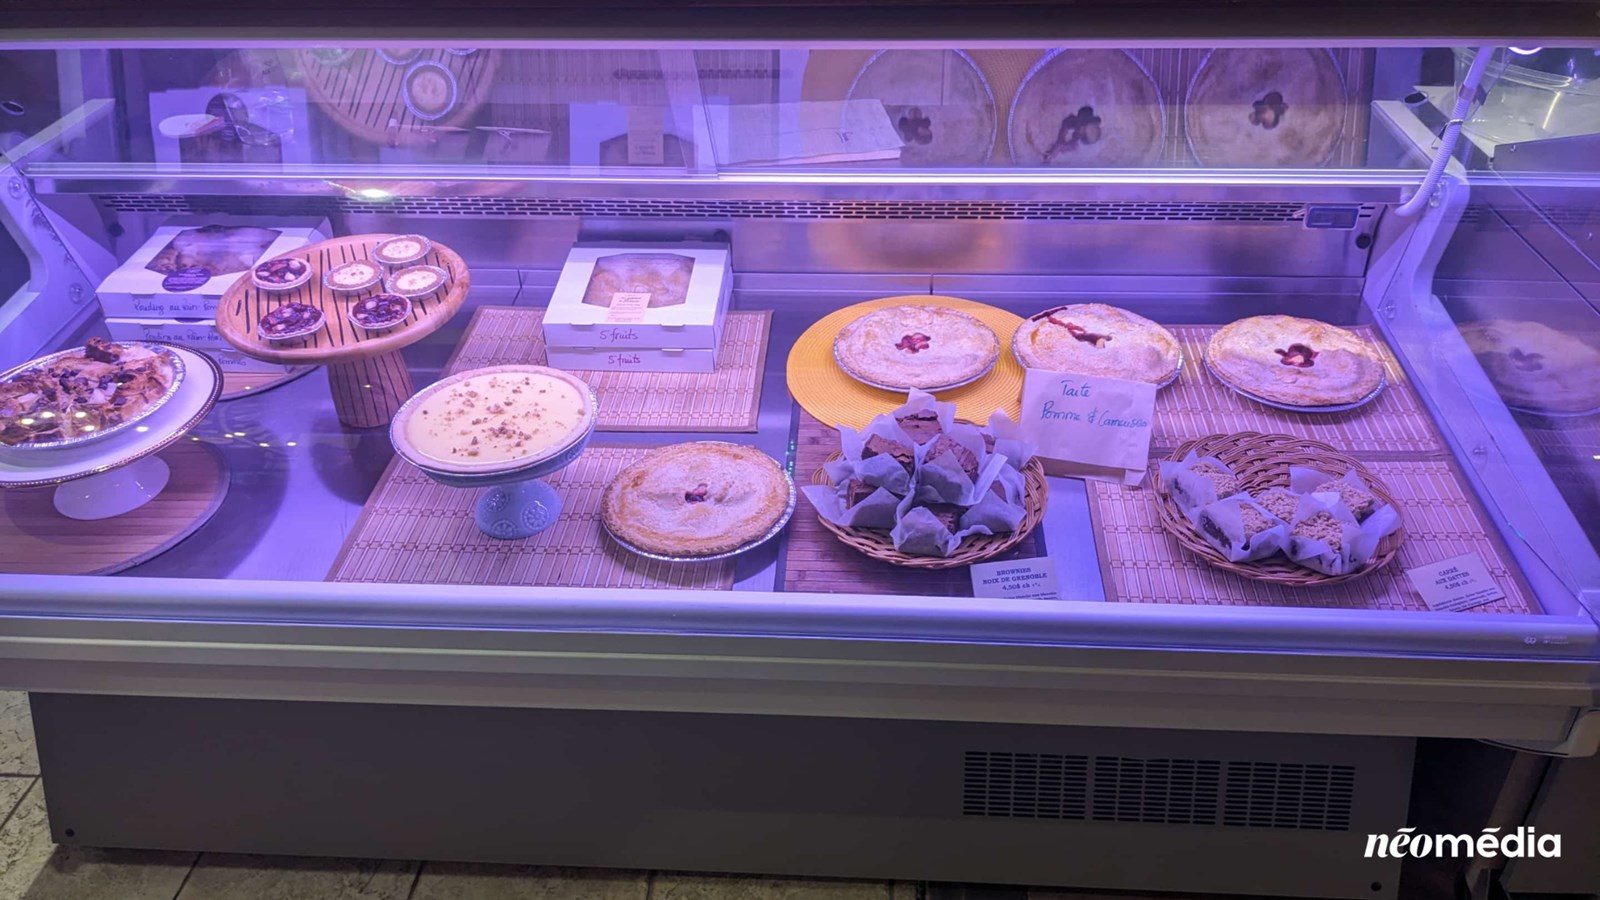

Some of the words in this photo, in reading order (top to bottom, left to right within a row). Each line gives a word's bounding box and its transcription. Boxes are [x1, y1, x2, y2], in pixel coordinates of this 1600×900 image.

[600, 330, 610, 340] 5
[610, 327, 639, 343] fruits
[608, 355, 617, 364] 5
[616, 353, 641, 367] fruits
[1040, 400, 1081, 421] Pomme
[996, 567, 1031, 576] BROWNIES
[1438, 566, 1458, 576] CARRÉ
[1448, 571, 1470, 581] DATTES
[1012, 573, 1048, 581] GRENOBLE
